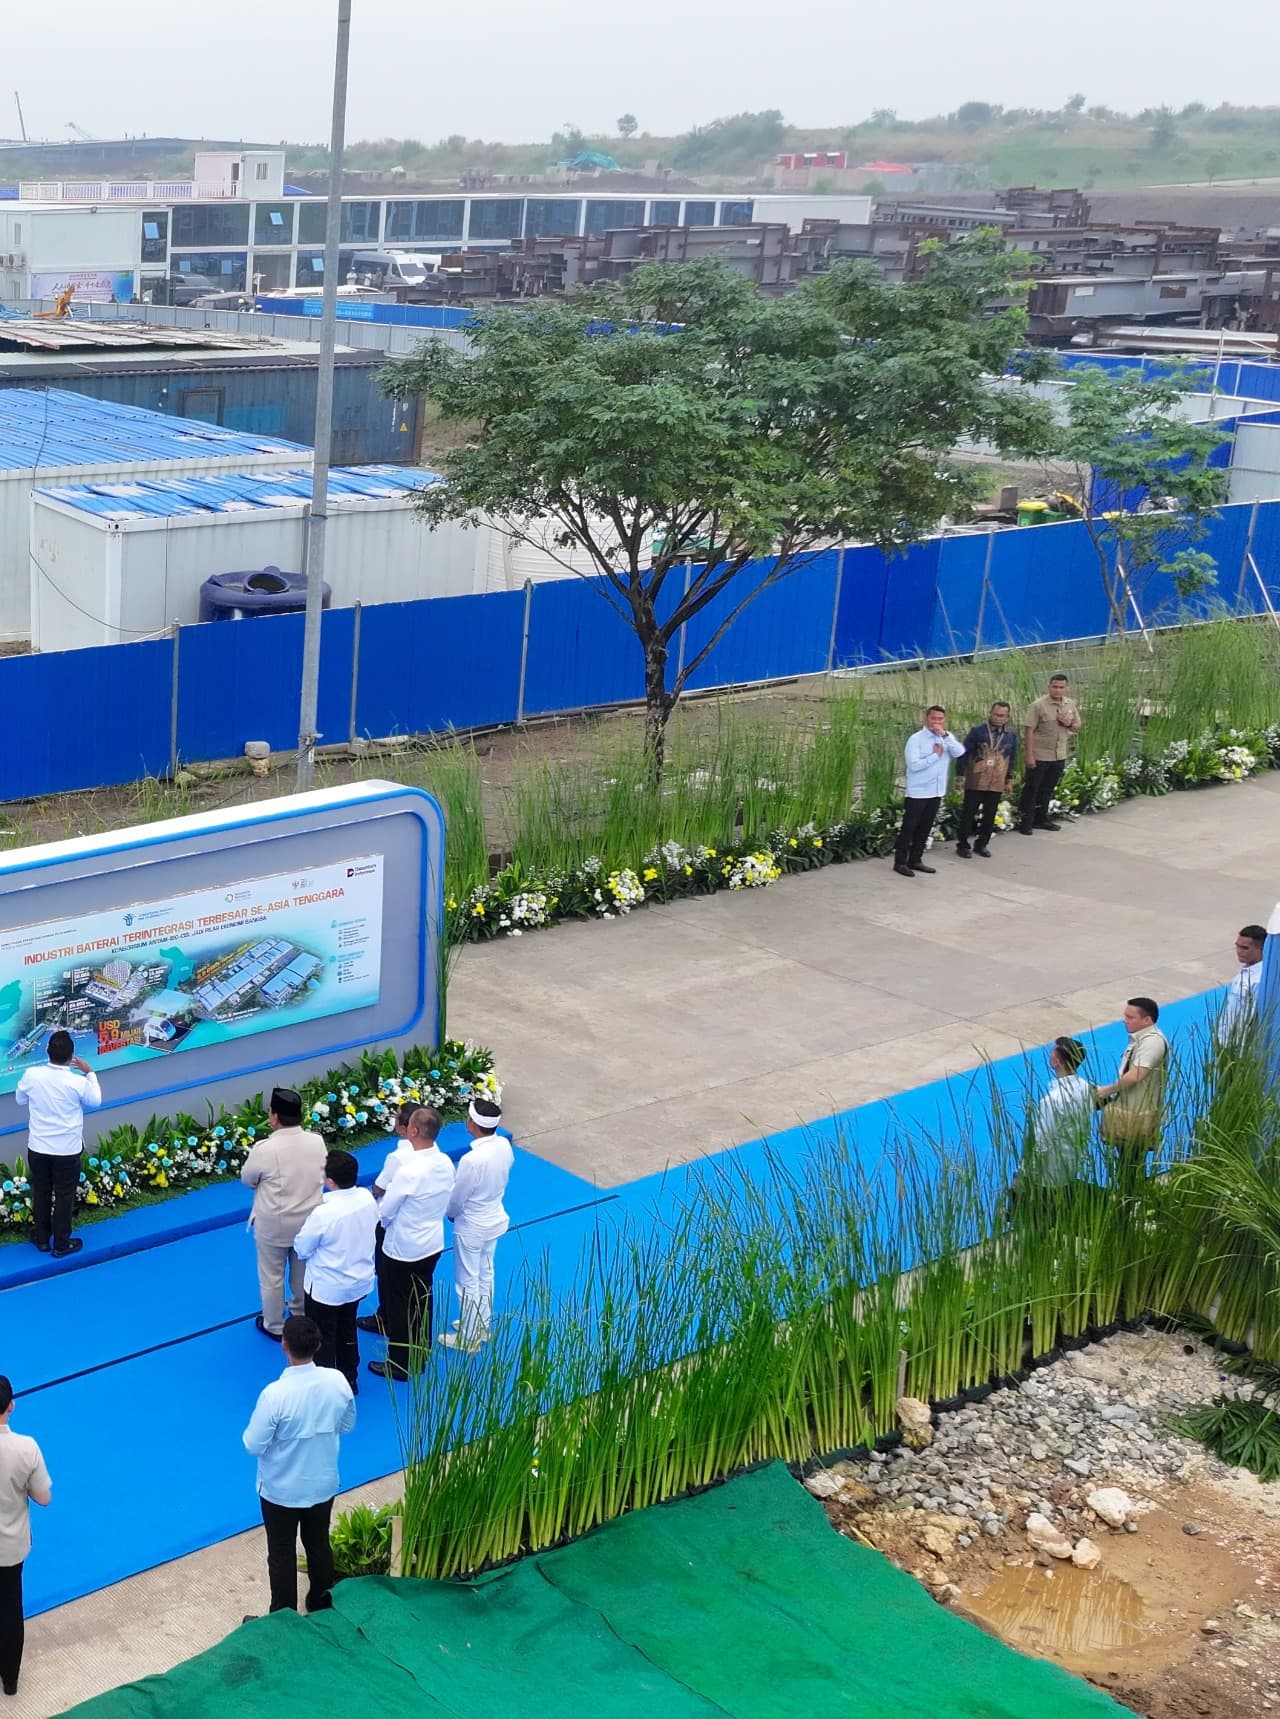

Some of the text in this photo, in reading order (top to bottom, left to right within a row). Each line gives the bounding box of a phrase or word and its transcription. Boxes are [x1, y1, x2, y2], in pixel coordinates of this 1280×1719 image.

[24, 945, 74, 965] INDUSTRI
[76, 934, 120, 955] BATERAI
[122, 920, 194, 943] TERINTEGRASI
[197, 909, 248, 928] TERBESAR
[251, 899, 290, 916] SE-ASIA
[293, 887, 345, 906] TENGGARA
[98, 1020, 120, 1031] USD
